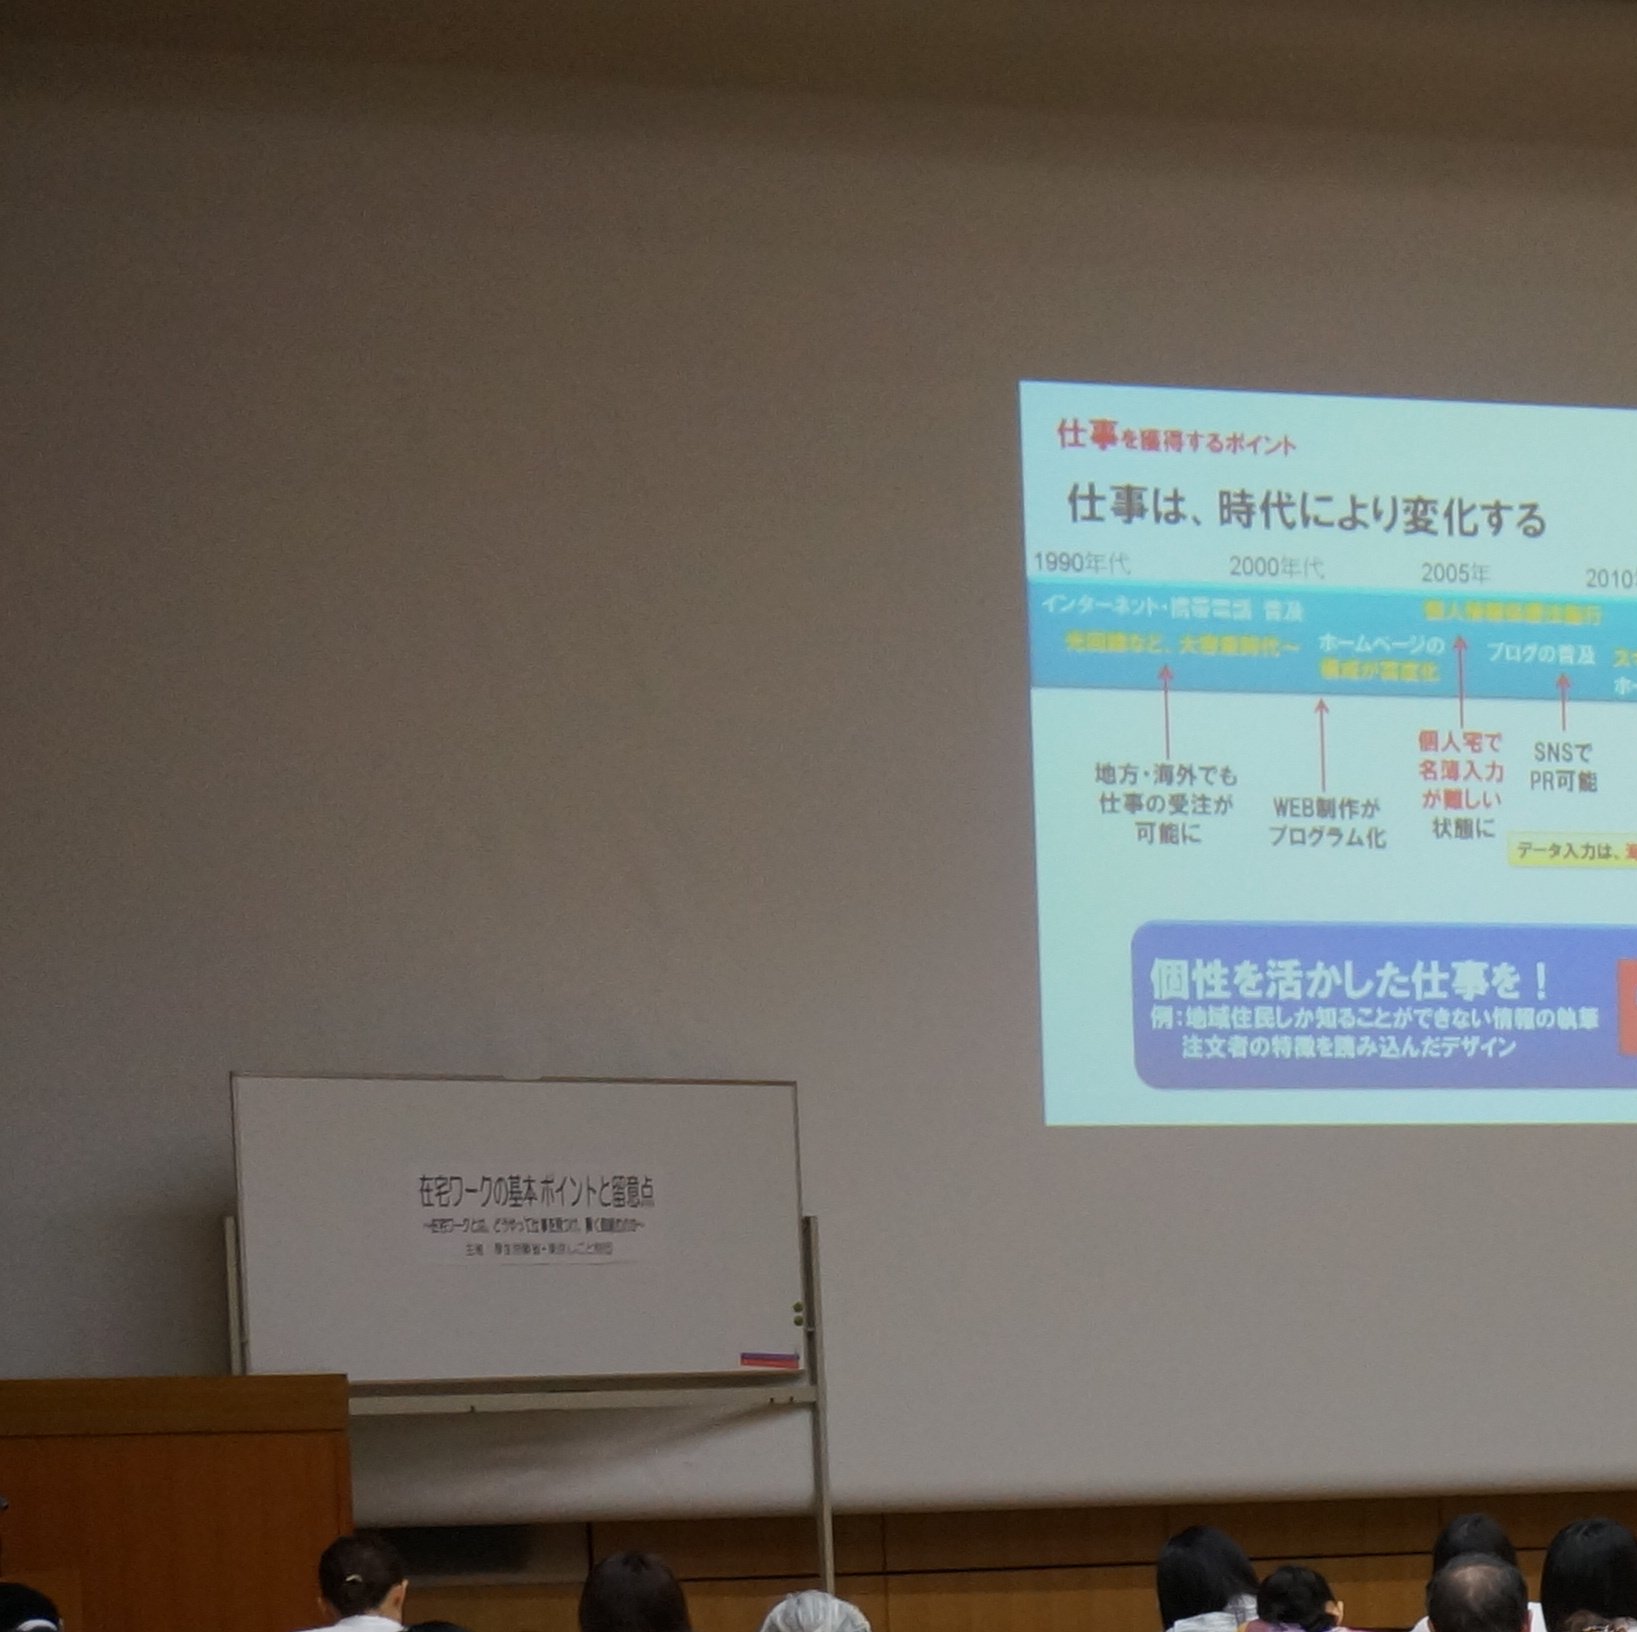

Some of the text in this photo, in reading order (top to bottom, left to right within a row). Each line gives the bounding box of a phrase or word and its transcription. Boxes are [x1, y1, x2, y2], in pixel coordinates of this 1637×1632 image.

[1057, 417, 1297, 456] 仕事を獲得するポイント
[1066, 481, 1547, 538] 仕事は、時代により変化する
[1421, 561, 1491, 585] 2005年
[1318, 632, 1446, 656] ホームページの
[1487, 642, 1597, 667] ブログの普及
[1418, 728, 1503, 754] 個人宅で
[1533, 741, 1593, 764] SNSで
[1094, 761, 1239, 788] 地方・海外でも
[1418, 759, 1504, 783] 名簿入力
[1529, 769, 1599, 794] PR可能
[1098, 790, 1235, 816] 仕事の受注が
[1271, 796, 1381, 821] WEB制作が
[1421, 788, 1502, 812] が難しい
[1134, 820, 1203, 846] 可能に
[1268, 824, 1388, 850] プログラム化
[1431, 816, 1496, 841] 状態に
[1149, 957, 1547, 1001] 個性を活かした仕事を！
